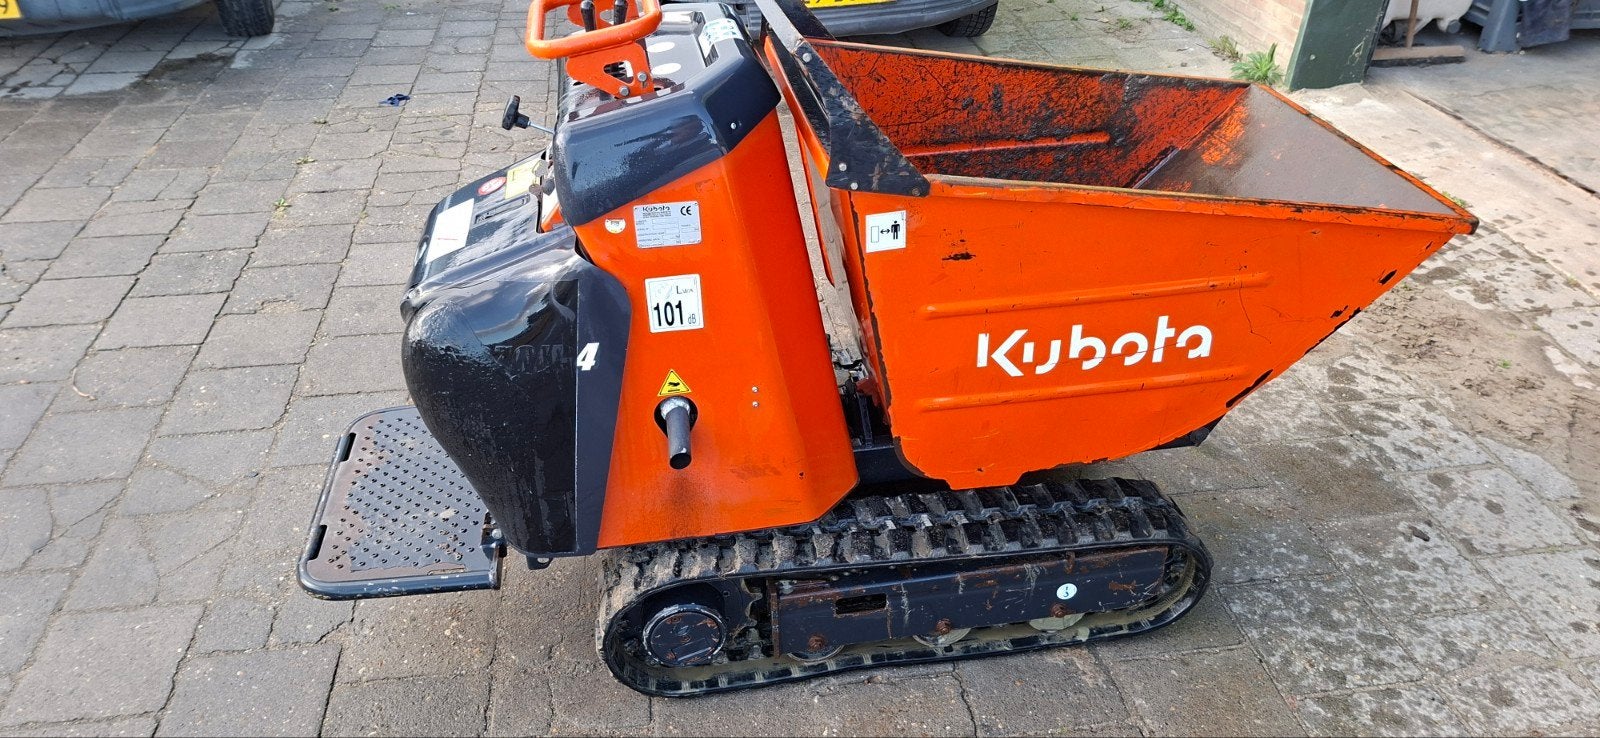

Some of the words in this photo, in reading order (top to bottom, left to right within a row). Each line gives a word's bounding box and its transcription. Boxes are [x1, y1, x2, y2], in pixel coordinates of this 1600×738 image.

[642, 204, 671, 213] Kubota
[680, 205, 692, 217] CE
[653, 300, 684, 327] 101
[688, 313, 697, 325] dB
[577, 342, 600, 372] 4
[976, 315, 1213, 377] Kubota
